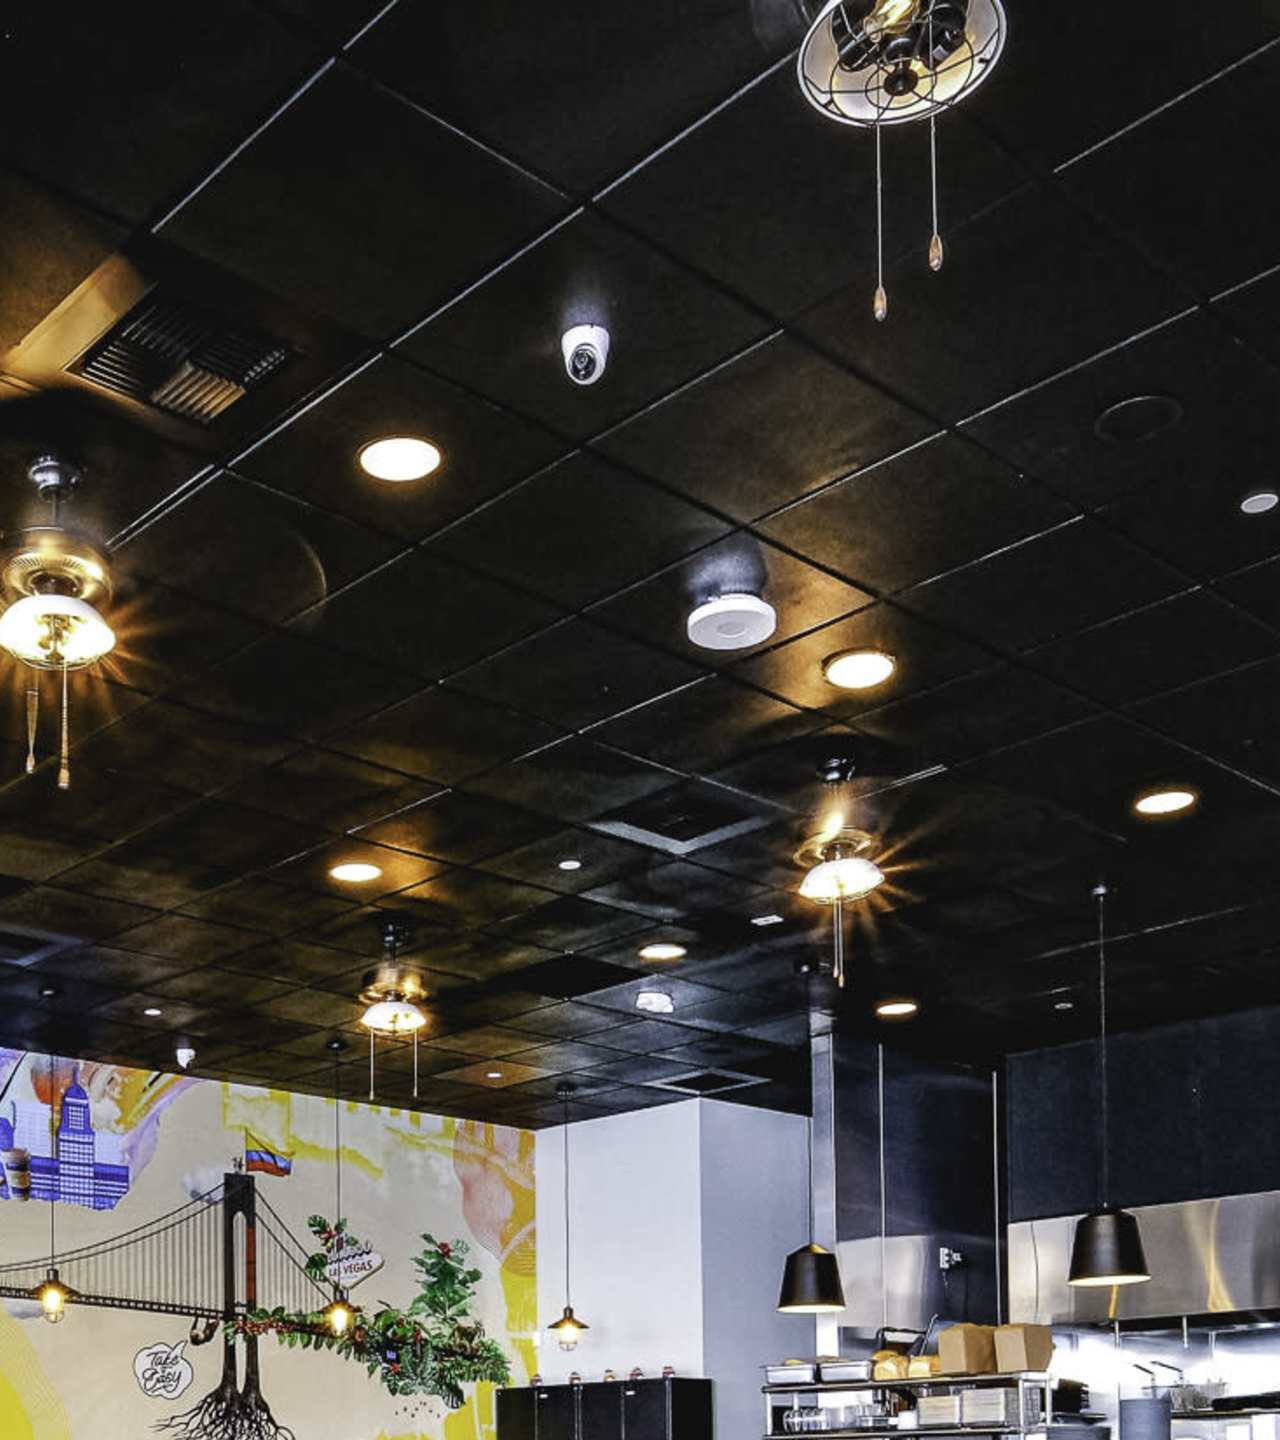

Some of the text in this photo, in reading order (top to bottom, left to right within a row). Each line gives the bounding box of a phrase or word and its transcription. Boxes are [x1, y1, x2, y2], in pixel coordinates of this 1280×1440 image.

[343, 1260, 373, 1274] VEGAS
[146, 1350, 180, 1369] Take
[142, 1367, 182, 1393] Easy
